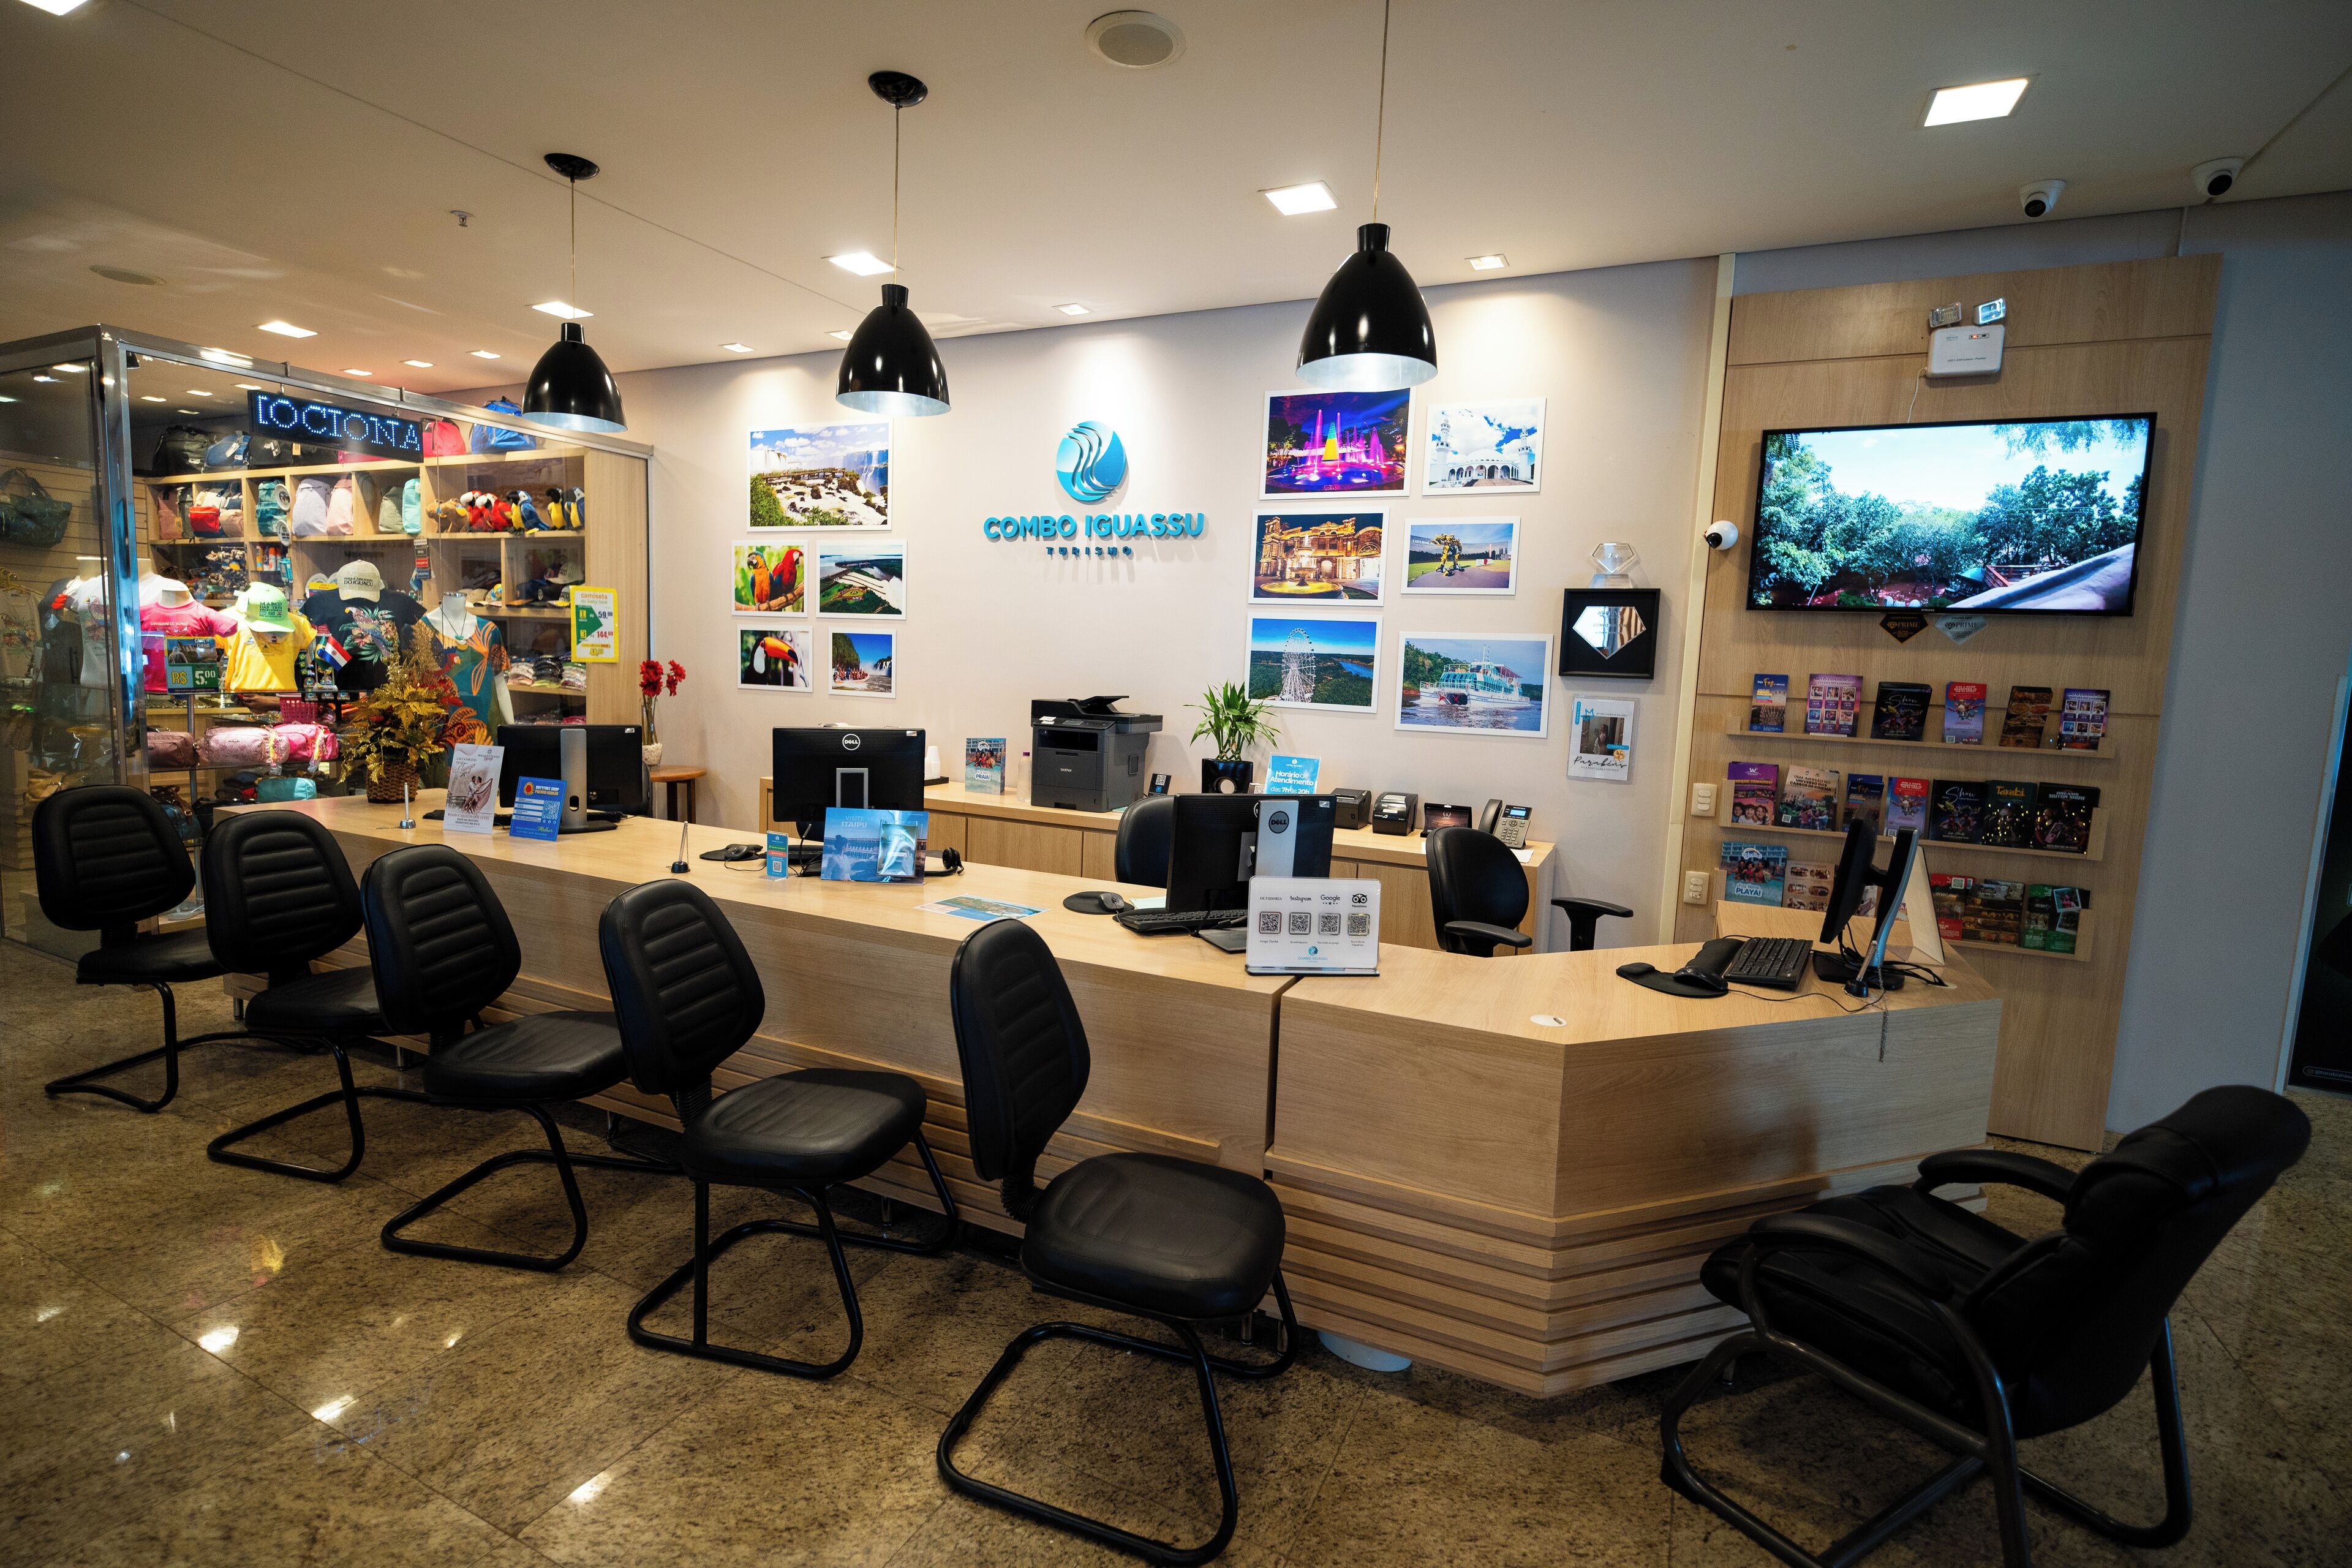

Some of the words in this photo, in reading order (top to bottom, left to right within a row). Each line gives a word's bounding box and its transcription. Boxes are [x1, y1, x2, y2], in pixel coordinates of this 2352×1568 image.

[984, 514, 1078, 539] COMBO
[1085, 513, 1204, 537] IGUASSU
[1046, 546, 1133, 556] TURISMO
[172, 671, 187, 685] R$
[195, 670, 216, 685] 5,00
[1574, 755, 1627, 768] Parabéns
[1270, 776, 1314, 786] Atendimento
[1946, 786, 1976, 804] Show
[1736, 888, 1761, 897] PLAYA!
